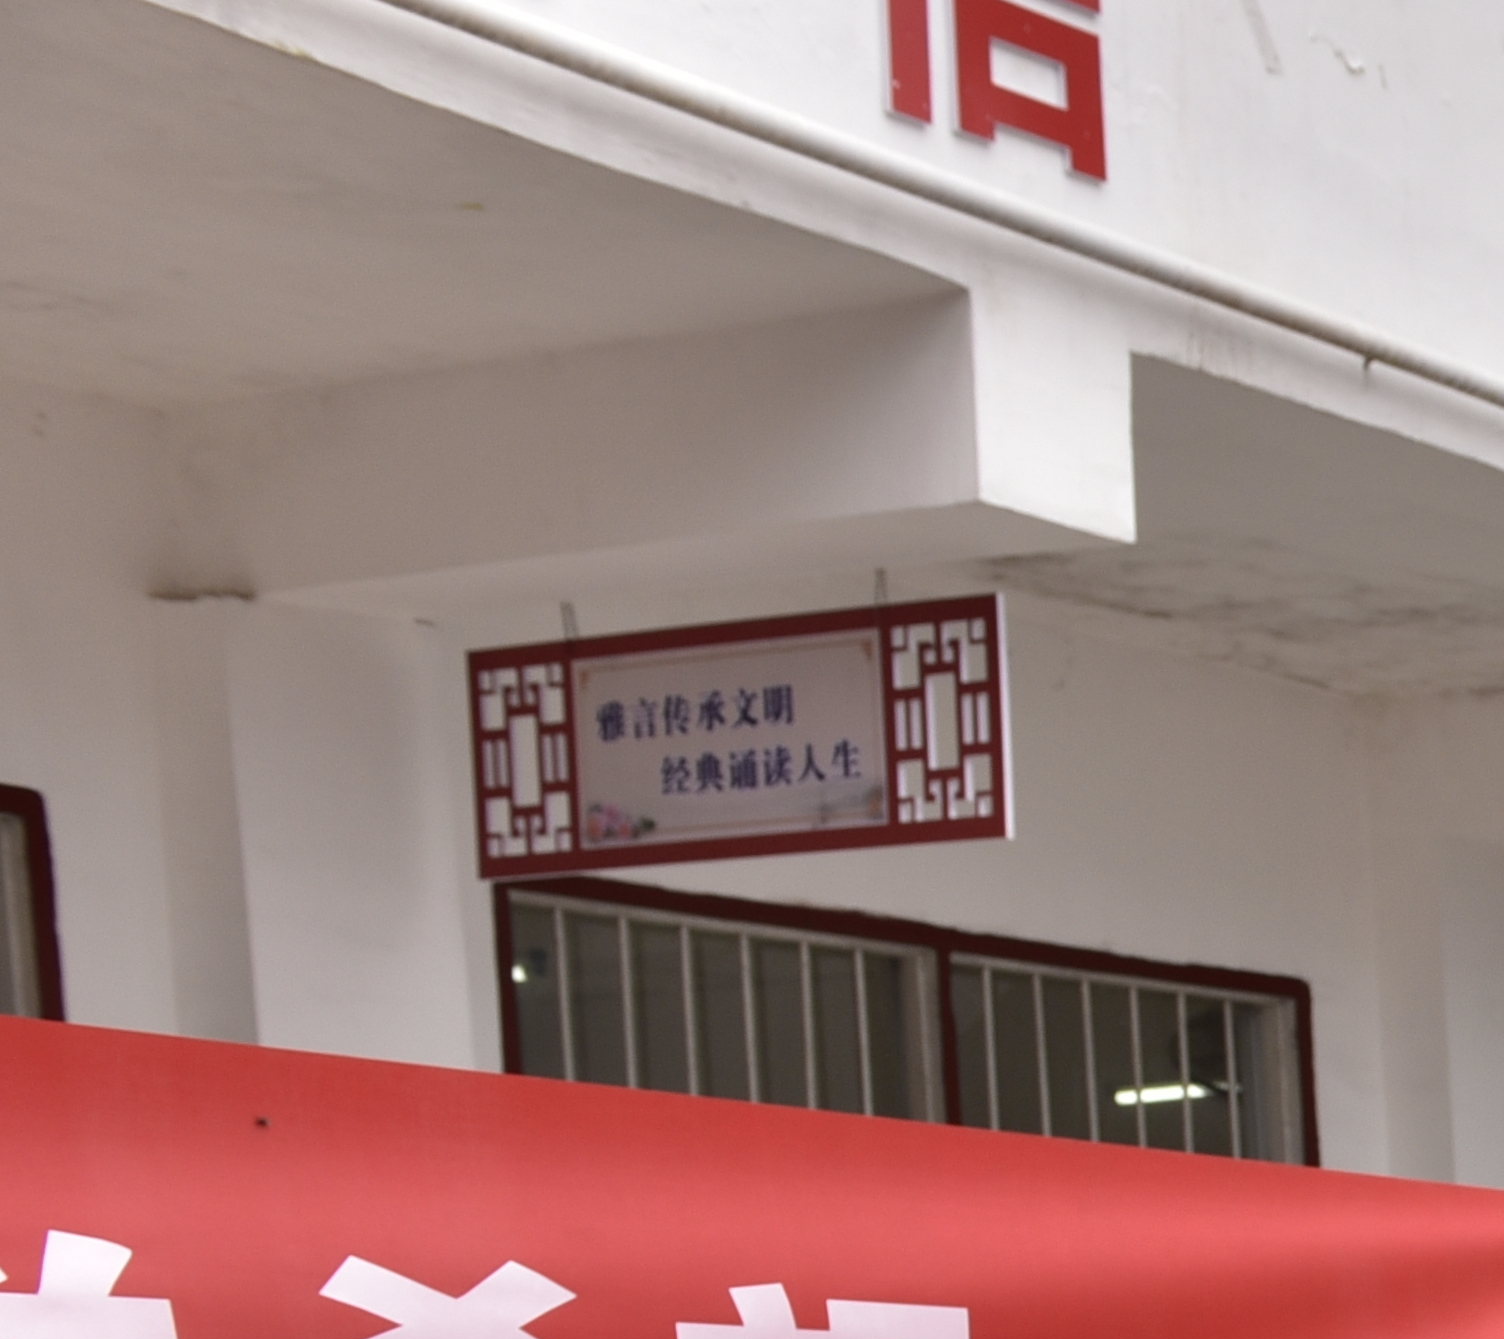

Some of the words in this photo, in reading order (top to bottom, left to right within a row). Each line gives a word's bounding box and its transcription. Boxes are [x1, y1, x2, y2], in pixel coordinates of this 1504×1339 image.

[596, 684, 793, 743] 雅言传承文明
[661, 740, 862, 795] 经典诵读人生
